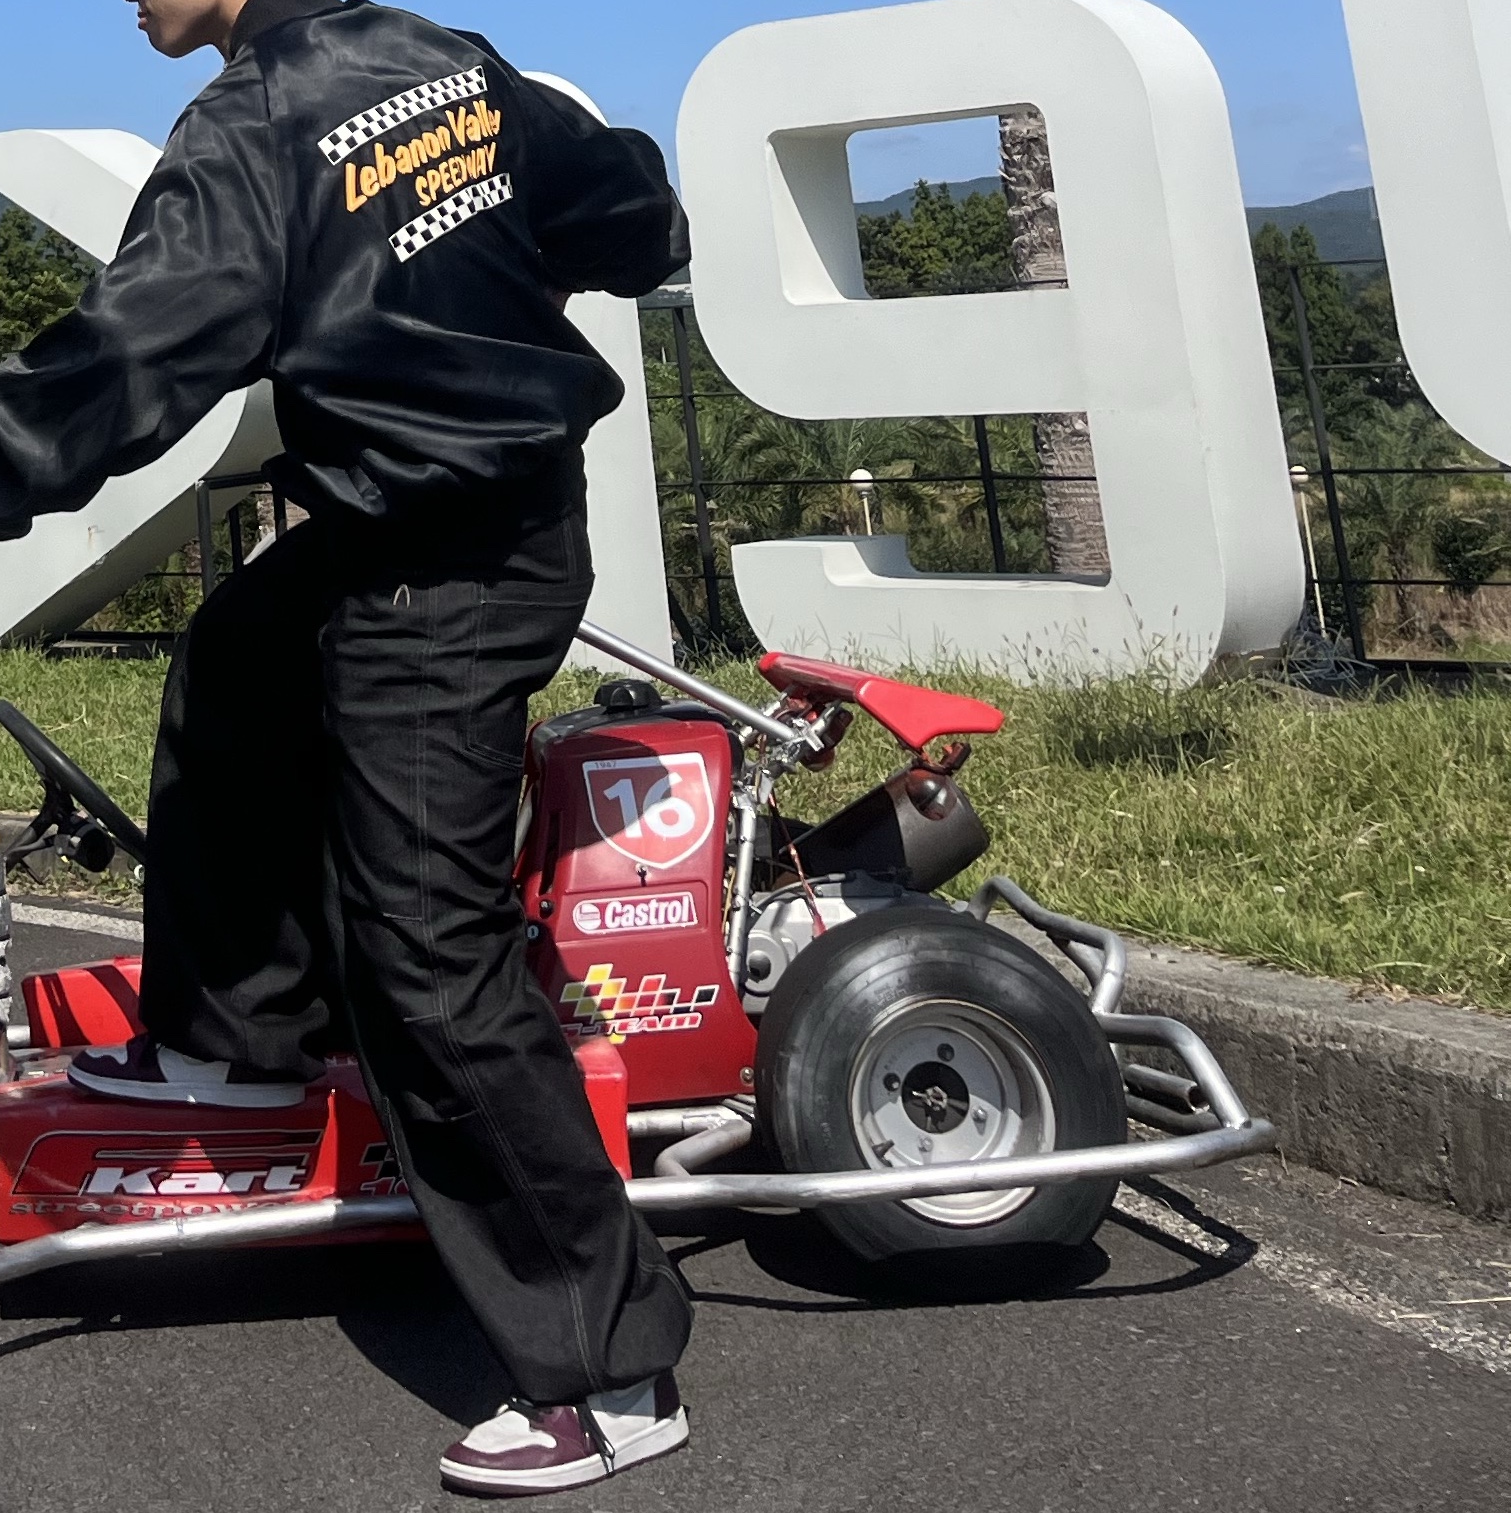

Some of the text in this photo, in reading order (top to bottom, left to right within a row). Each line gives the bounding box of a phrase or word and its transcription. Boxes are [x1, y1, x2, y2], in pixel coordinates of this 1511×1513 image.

[345, 125, 451, 212] Lebanon
[415, 141, 497, 207] SPEEDWAY
[603, 771, 696, 838] 16
[604, 895, 690, 929] Castrol
[86, 1165, 307, 1194] Kart
